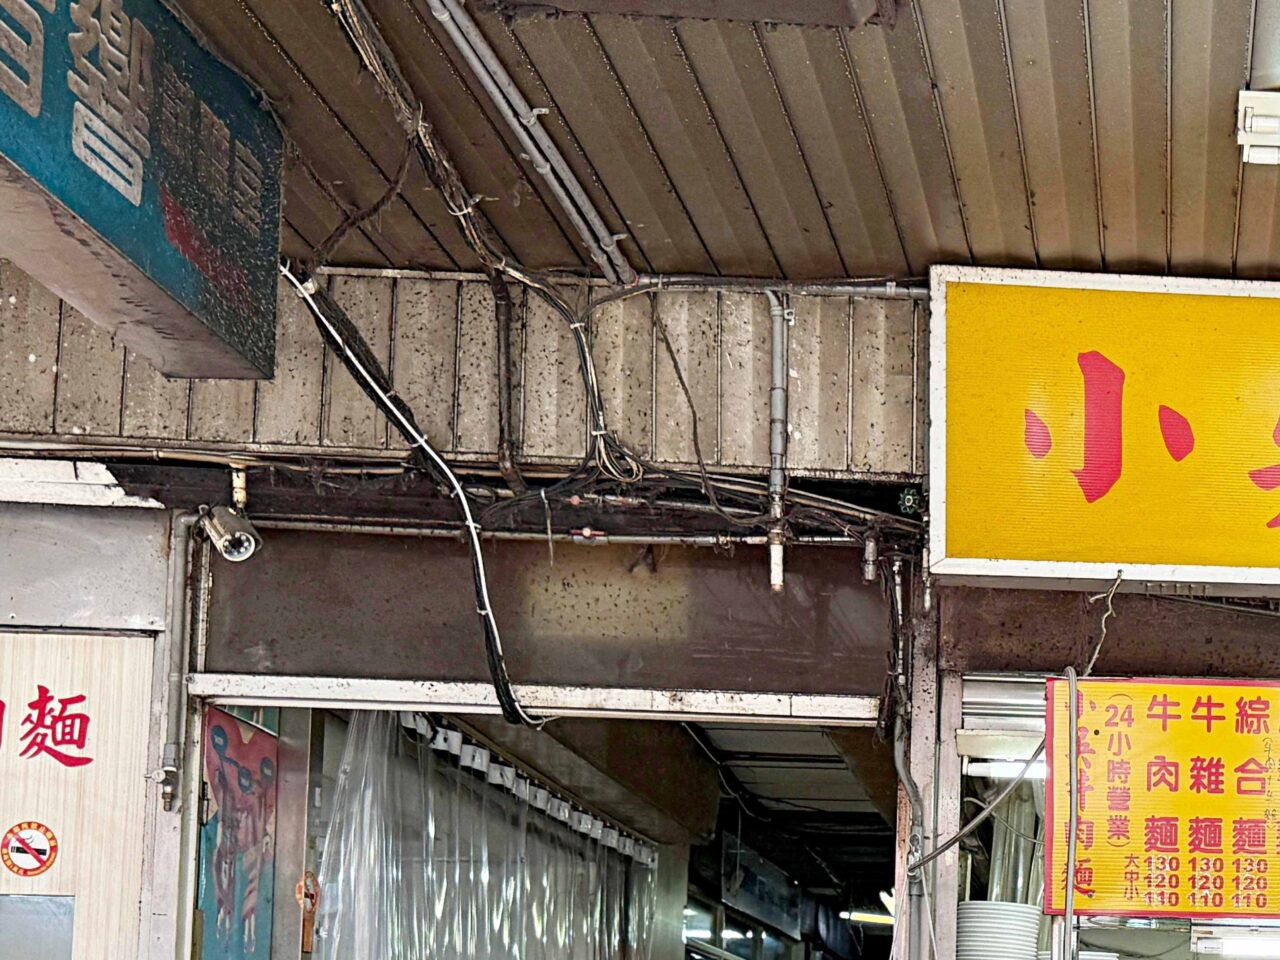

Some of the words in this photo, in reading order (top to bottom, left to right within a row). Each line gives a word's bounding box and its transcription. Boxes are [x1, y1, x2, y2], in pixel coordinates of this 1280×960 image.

[0, 684, 93, 767] 麵
[1144, 693, 1182, 854] 牛肉麵
[1188, 694, 1226, 854] 牛雜麵
[1232, 695, 1271, 855] 綜合麵
[1144, 856, 1180, 872] 130
[1188, 856, 1224, 873] 130
[1232, 858, 1268, 873] 130
[1144, 874, 1180, 889] 120
[1188, 874, 1224, 890] 120
[1232, 875, 1268, 890] 120
[1144, 891, 1180, 907] 110
[1188, 892, 1224, 908] 110
[1232, 893, 1268, 908] 110
